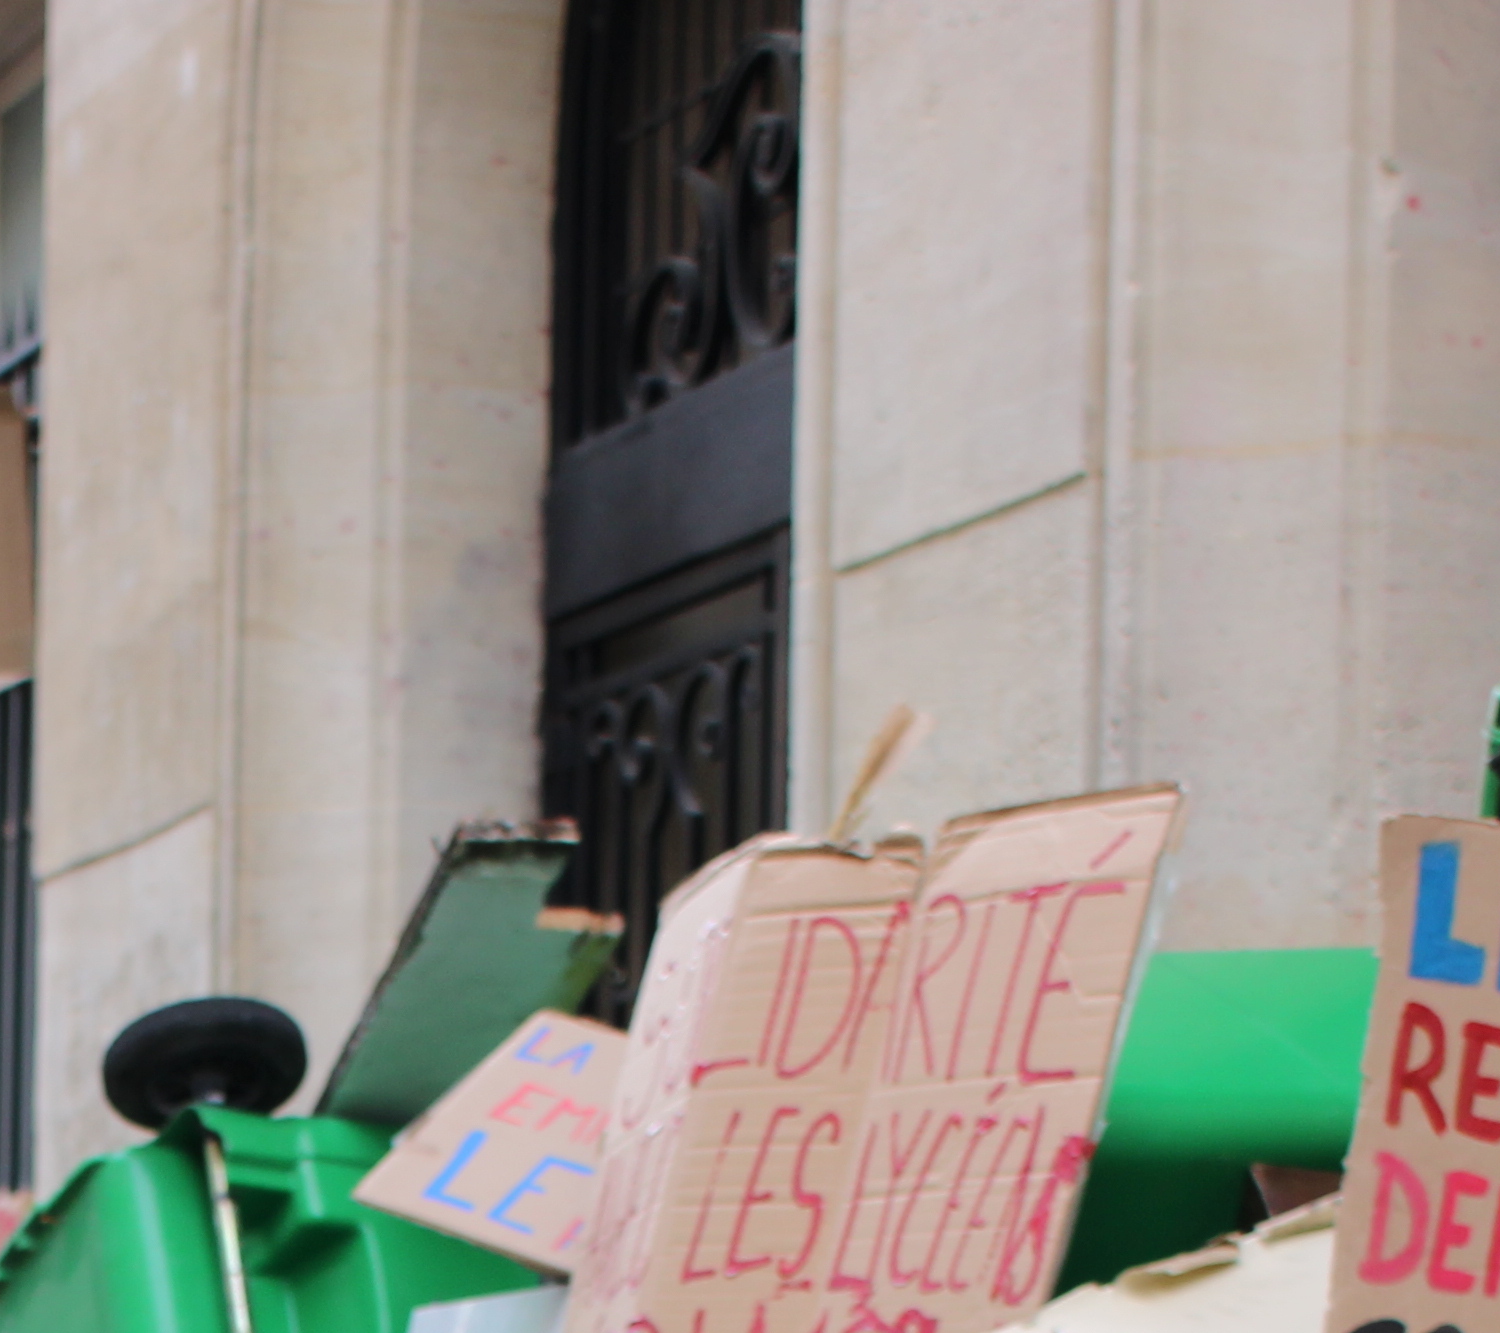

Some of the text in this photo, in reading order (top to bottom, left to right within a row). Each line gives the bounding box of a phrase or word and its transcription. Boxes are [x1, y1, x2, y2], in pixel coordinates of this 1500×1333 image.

[514, 1025, 594, 1075] LA
[421, 1129, 596, 1236] LE
[680, 1106, 843, 1284] LES
